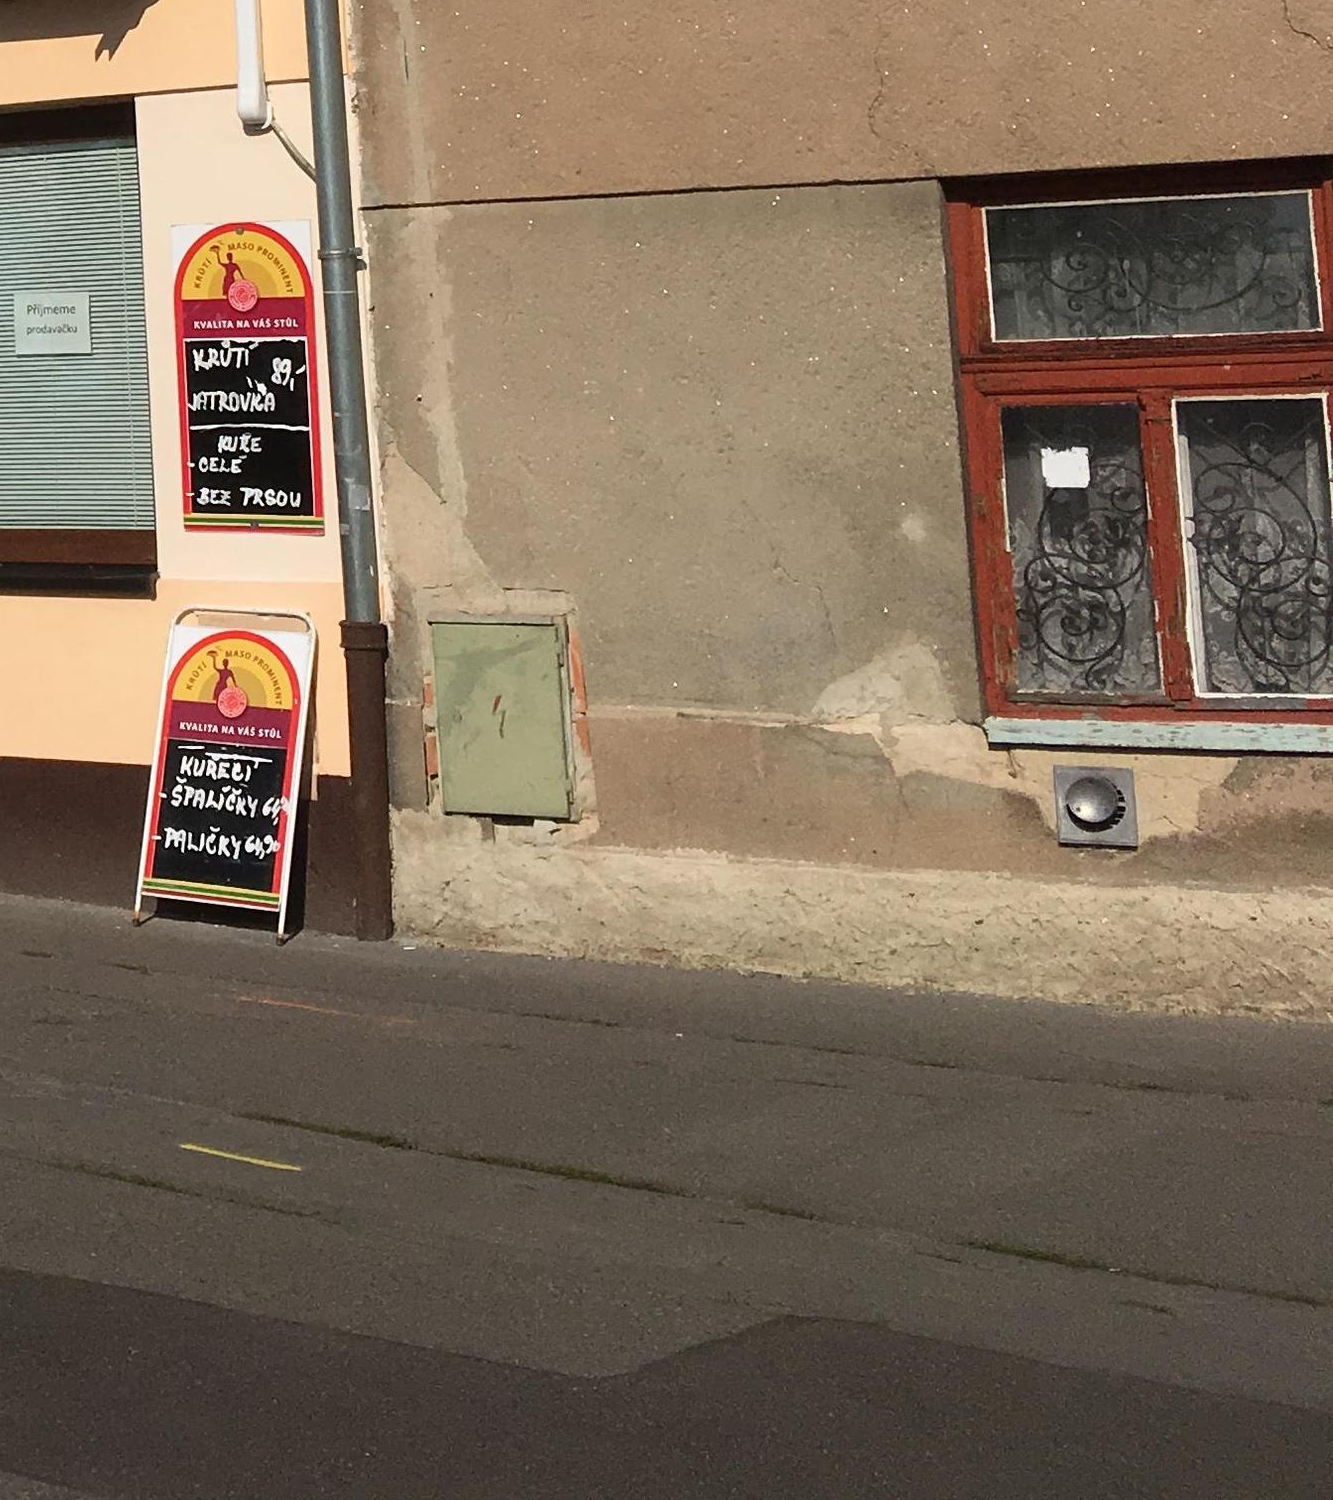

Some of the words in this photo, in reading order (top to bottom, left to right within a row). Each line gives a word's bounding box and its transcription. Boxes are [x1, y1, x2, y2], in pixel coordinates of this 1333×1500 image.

[227, 242, 255, 251] MASO
[256, 245, 294, 293] PROMINENT
[193, 320, 234, 330] KVALITA
[236, 319, 251, 329] NA
[252, 317, 271, 329] VÁŠ
[273, 317, 299, 328] STŮL
[239, 486, 302, 509] PRSOU
[224, 649, 252, 660] MASO
[252, 654, 283, 706] PROMINENT
[179, 721, 219, 734] KVALITA
[221, 725, 235, 735] NA
[237, 725, 256, 737] VÁŠ
[258, 727, 282, 739] STŮL
